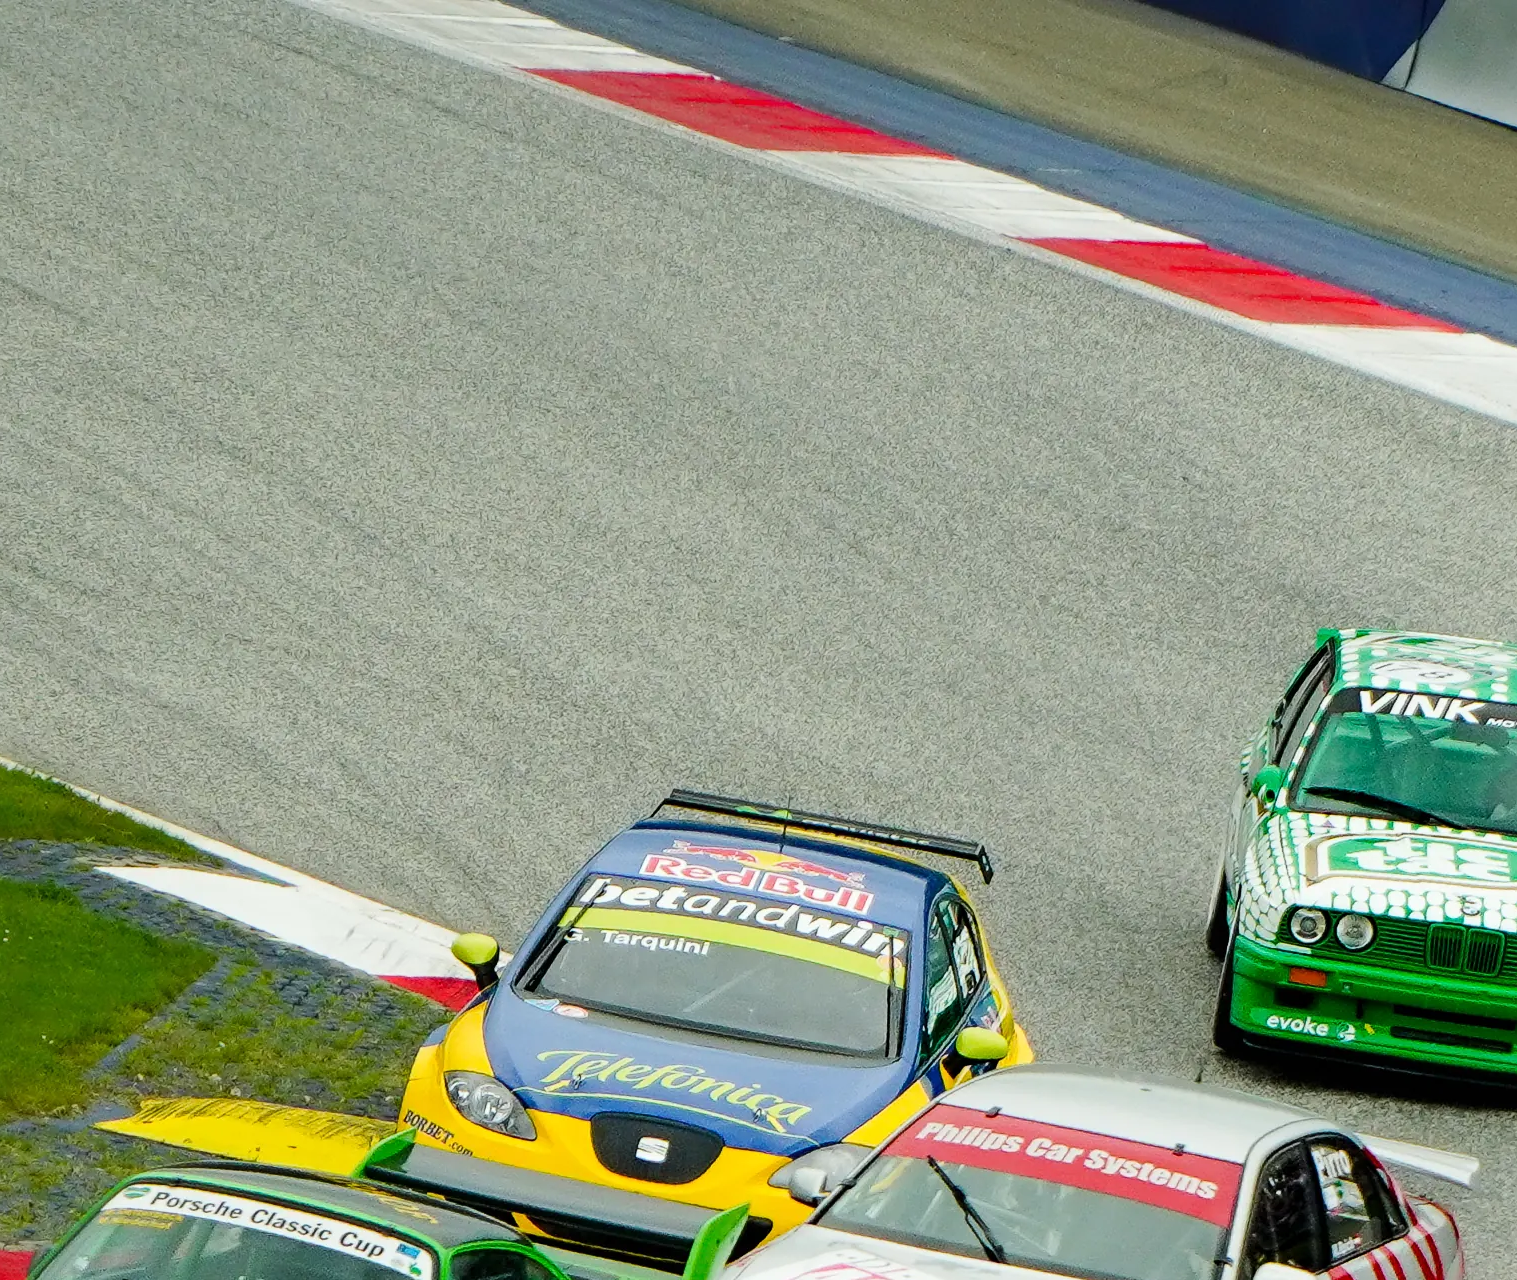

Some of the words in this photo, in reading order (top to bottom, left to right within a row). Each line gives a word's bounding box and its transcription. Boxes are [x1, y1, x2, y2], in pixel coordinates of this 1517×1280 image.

[1359, 690, 1486, 725] VINK
[639, 854, 761, 891] Red
[758, 871, 875, 916] Bull
[578, 877, 906, 957] betandwin
[600, 929, 711, 956] Tarquini
[1266, 1014, 1330, 1037] evoke
[915, 1121, 1025, 1153] Philips
[1025, 1137, 1085, 1165] Car
[1083, 1148, 1219, 1200] Systems
[150, 1191, 244, 1220] Porsche
[250, 1208, 334, 1242] Classic
[339, 1231, 385, 1259] Cup
